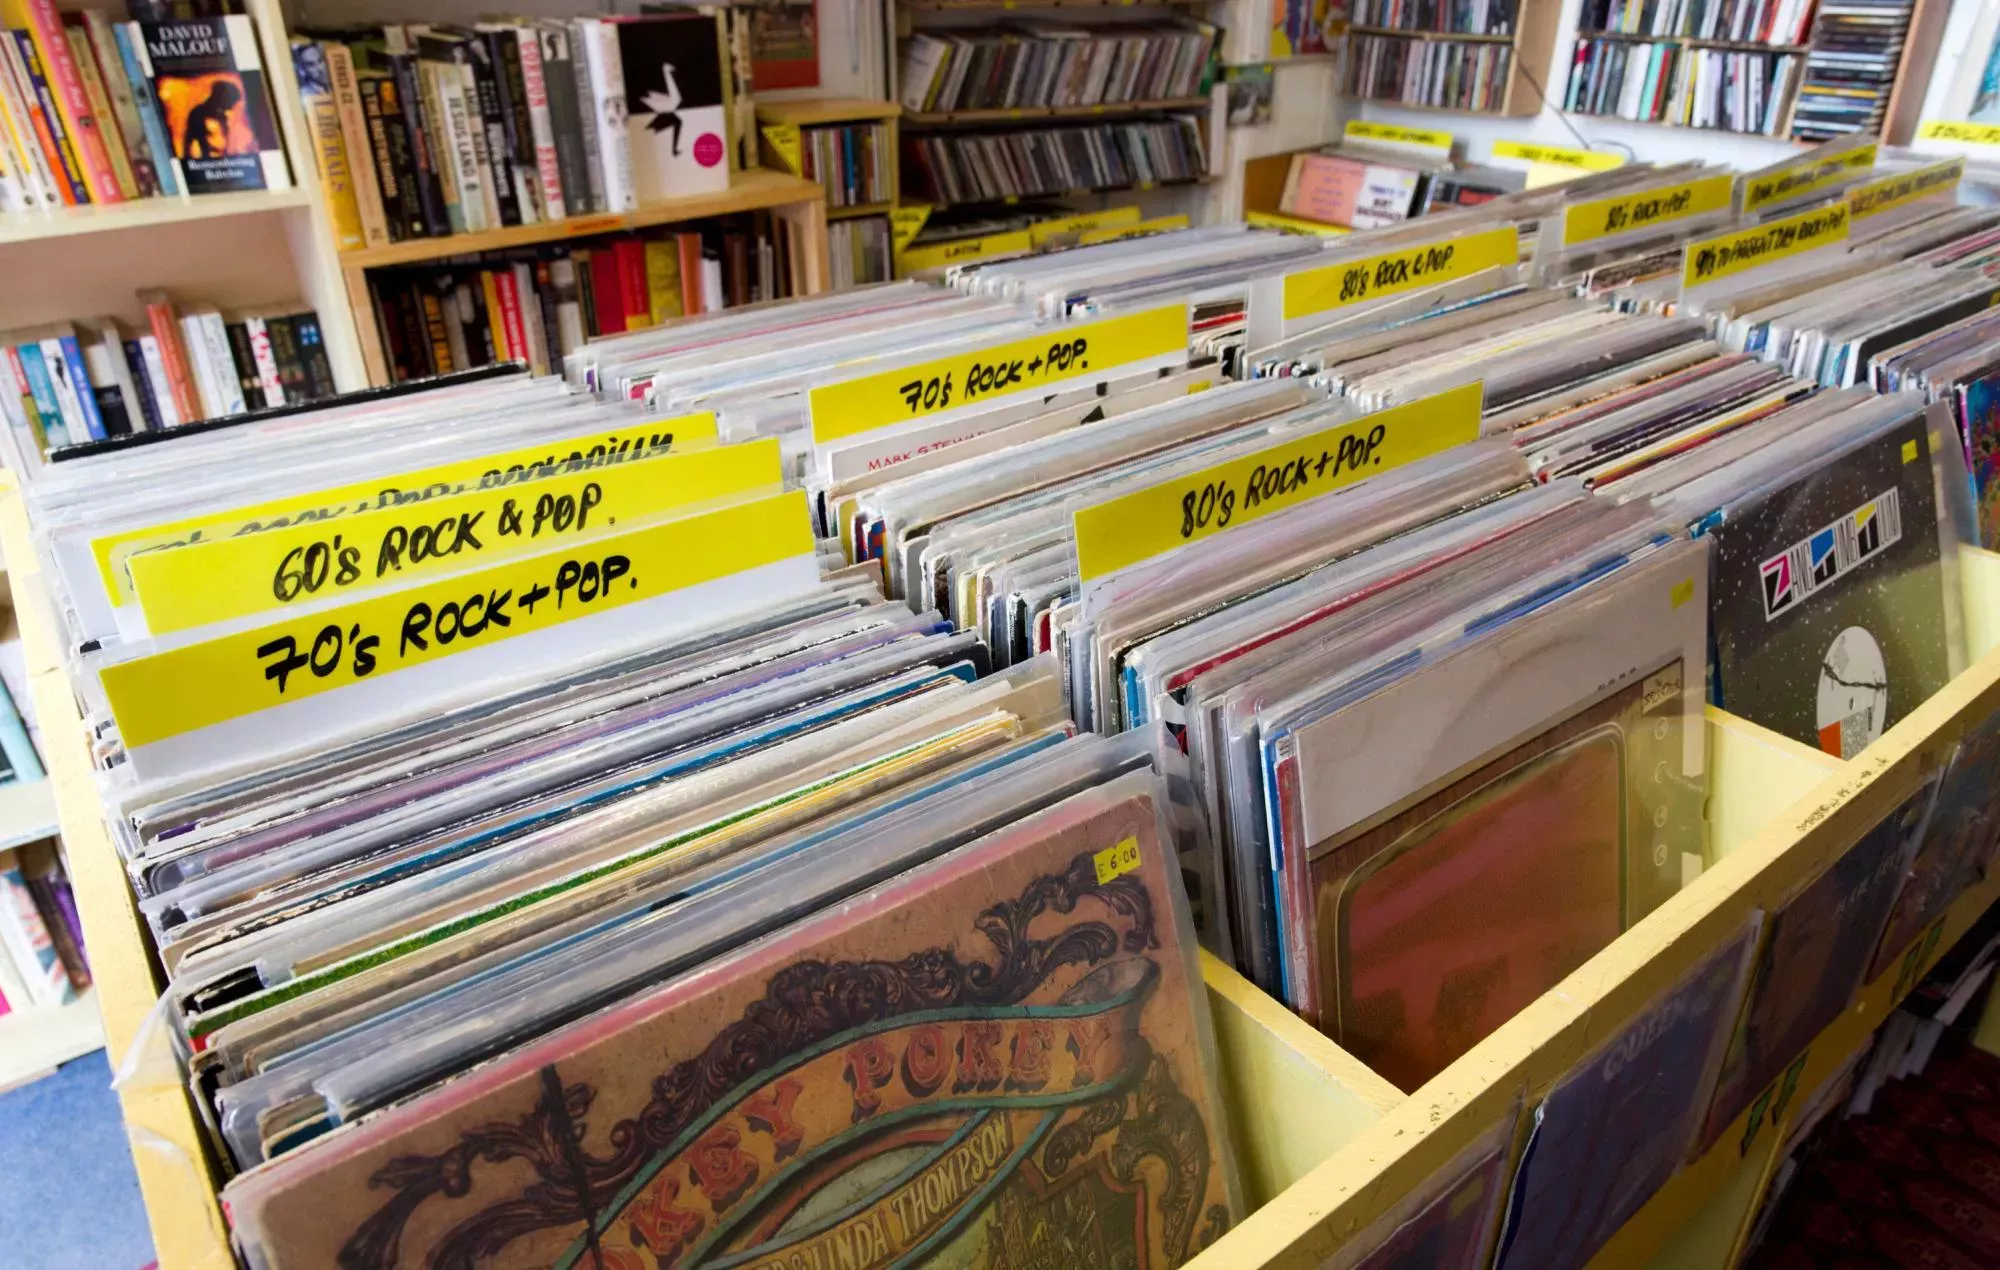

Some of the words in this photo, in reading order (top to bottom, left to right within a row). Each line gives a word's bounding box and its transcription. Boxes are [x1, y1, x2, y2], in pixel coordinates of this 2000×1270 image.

[149, 37, 228, 57] MALOUF
[158, 24, 213, 40] DAVID
[1339, 263, 1370, 302] 80's
[1373, 259, 1411, 289] ROCK
[900, 371, 953, 414] 70's
[868, 450, 913, 472] MARK
[1181, 480, 1235, 539] 80's
[273, 535, 362, 603] 60's
[376, 510, 485, 580] ROCK
[499, 498, 523, 537] &
[256, 623, 381, 696] 70's
[843, 1018, 1112, 1120] POKEY
[890, 1112, 1013, 1241] THOMPSON
